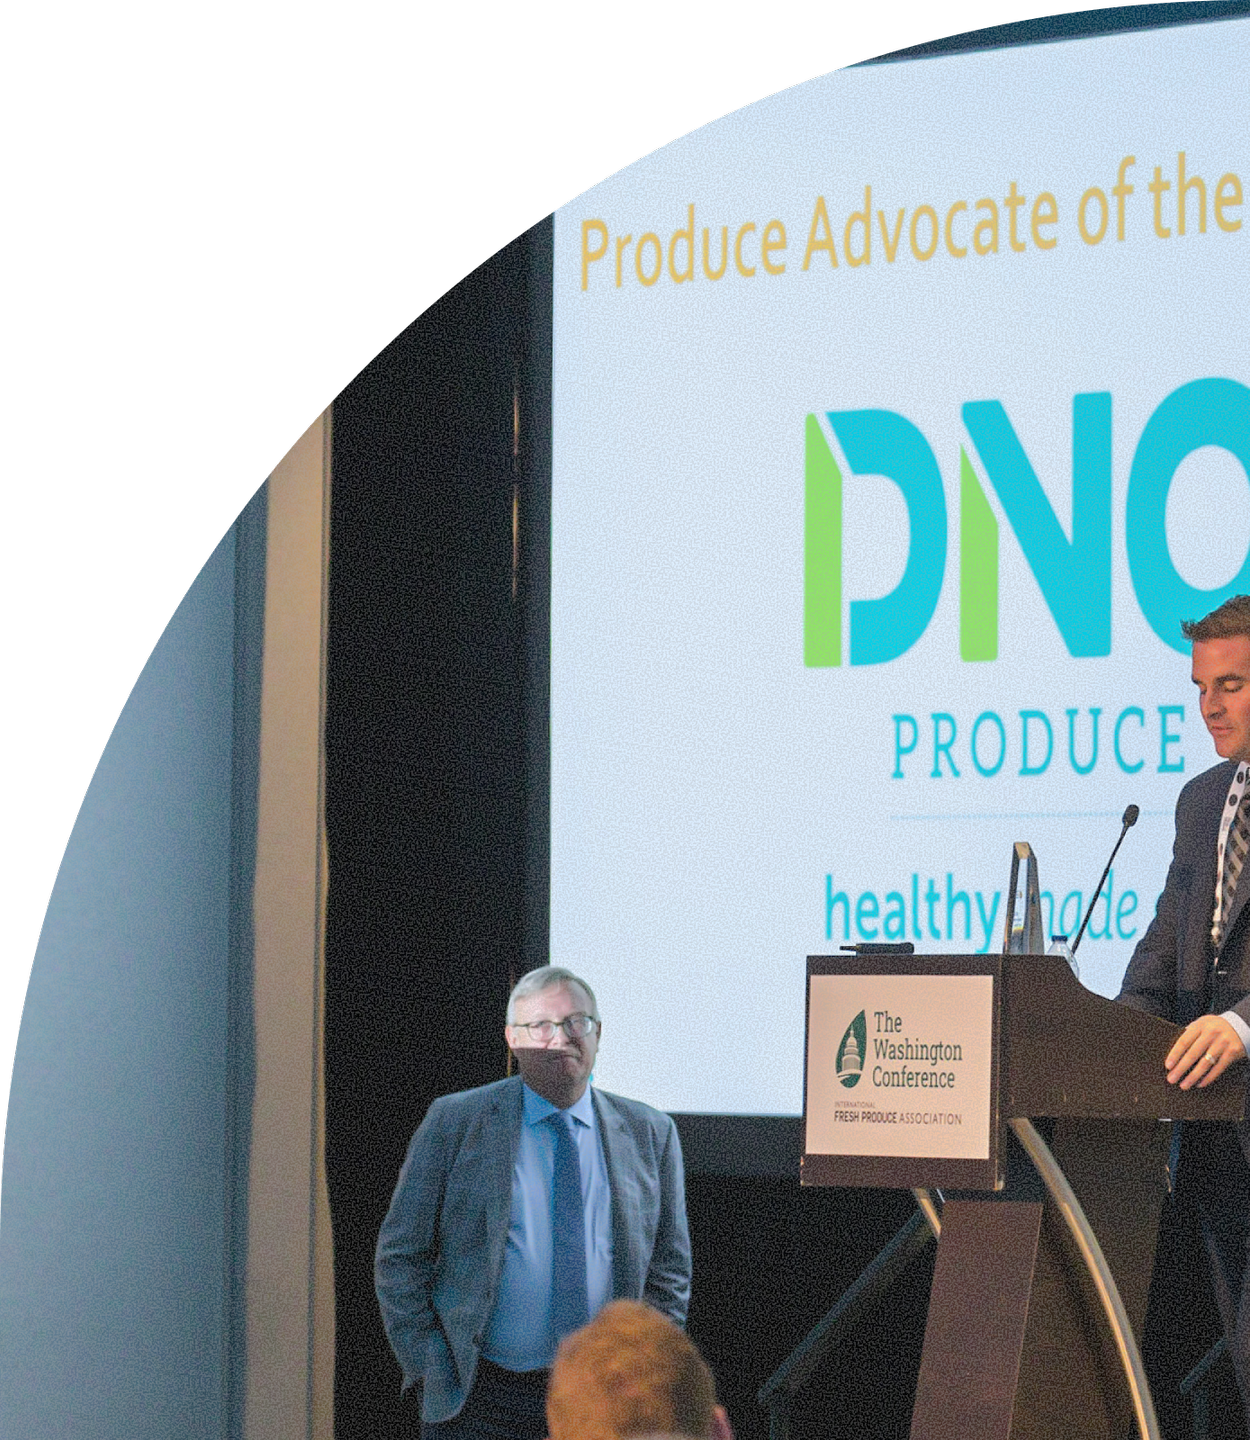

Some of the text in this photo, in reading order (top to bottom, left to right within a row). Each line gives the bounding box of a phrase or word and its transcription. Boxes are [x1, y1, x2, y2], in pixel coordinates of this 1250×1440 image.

[580, 203, 788, 291] Produce
[802, 182, 1059, 270] Advocate
[1077, 155, 1136, 245] of
[1148, 152, 1243, 238] the
[891, 704, 1186, 779] PRODUCE
[825, 872, 1001, 954] healthy
[873, 1010, 902, 1033] The
[873, 1038, 963, 1066] Washington
[872, 1065, 956, 1088] Conference
[834, 1100, 876, 1109] INTERNATIONAL
[834, 1110, 962, 1125] FRESH PRODUCE ASSOCIATION
